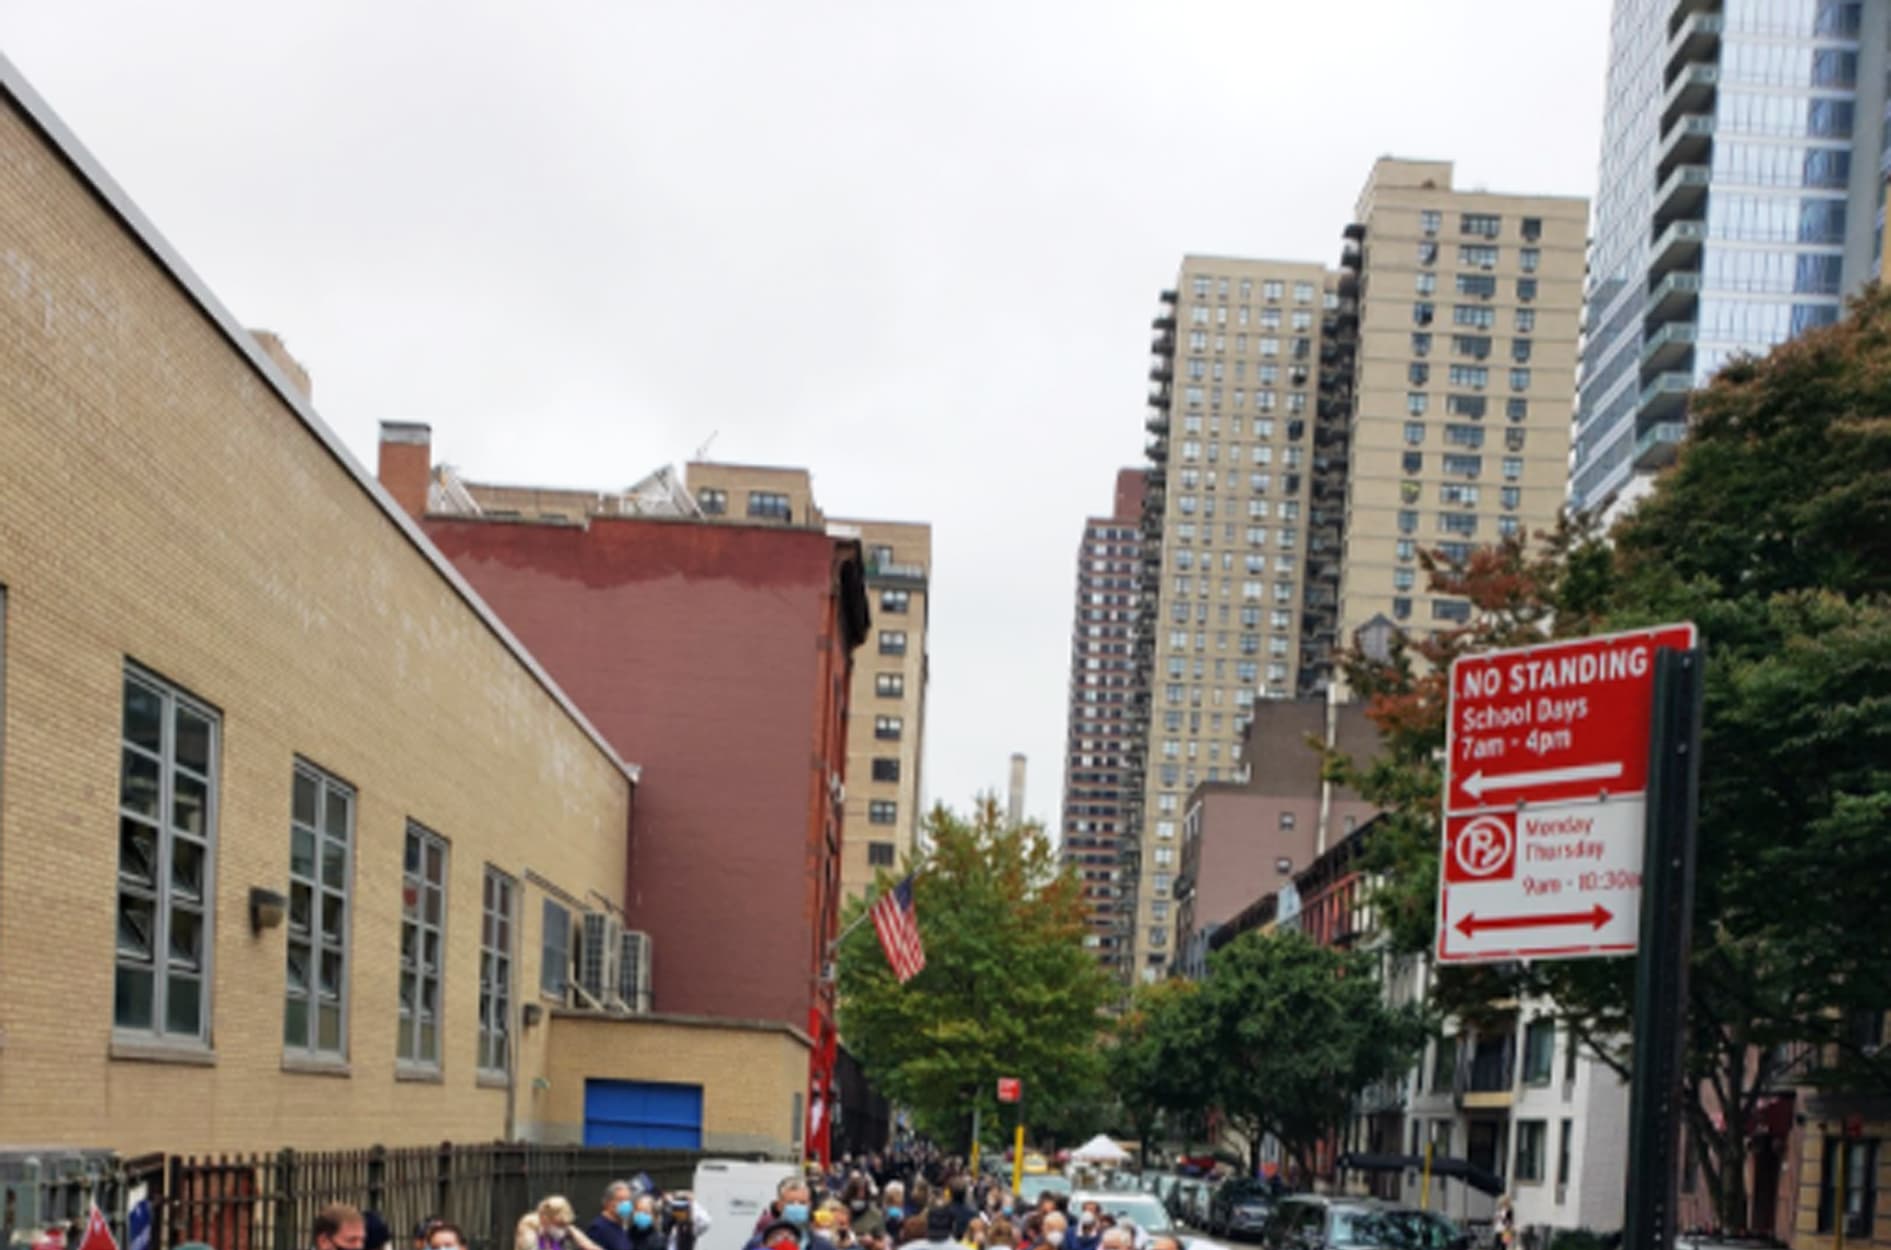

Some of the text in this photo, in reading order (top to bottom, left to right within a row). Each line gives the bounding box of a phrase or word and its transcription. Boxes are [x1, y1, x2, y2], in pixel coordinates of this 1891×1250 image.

[1463, 646, 1648, 698] NO STANDING
[1462, 697, 1588, 731] School Days
[1460, 735, 1504, 760] 7am
[1526, 728, 1572, 755] 4pm
[1525, 815, 1595, 837] Monday
[1525, 840, 1605, 861] Thursday
